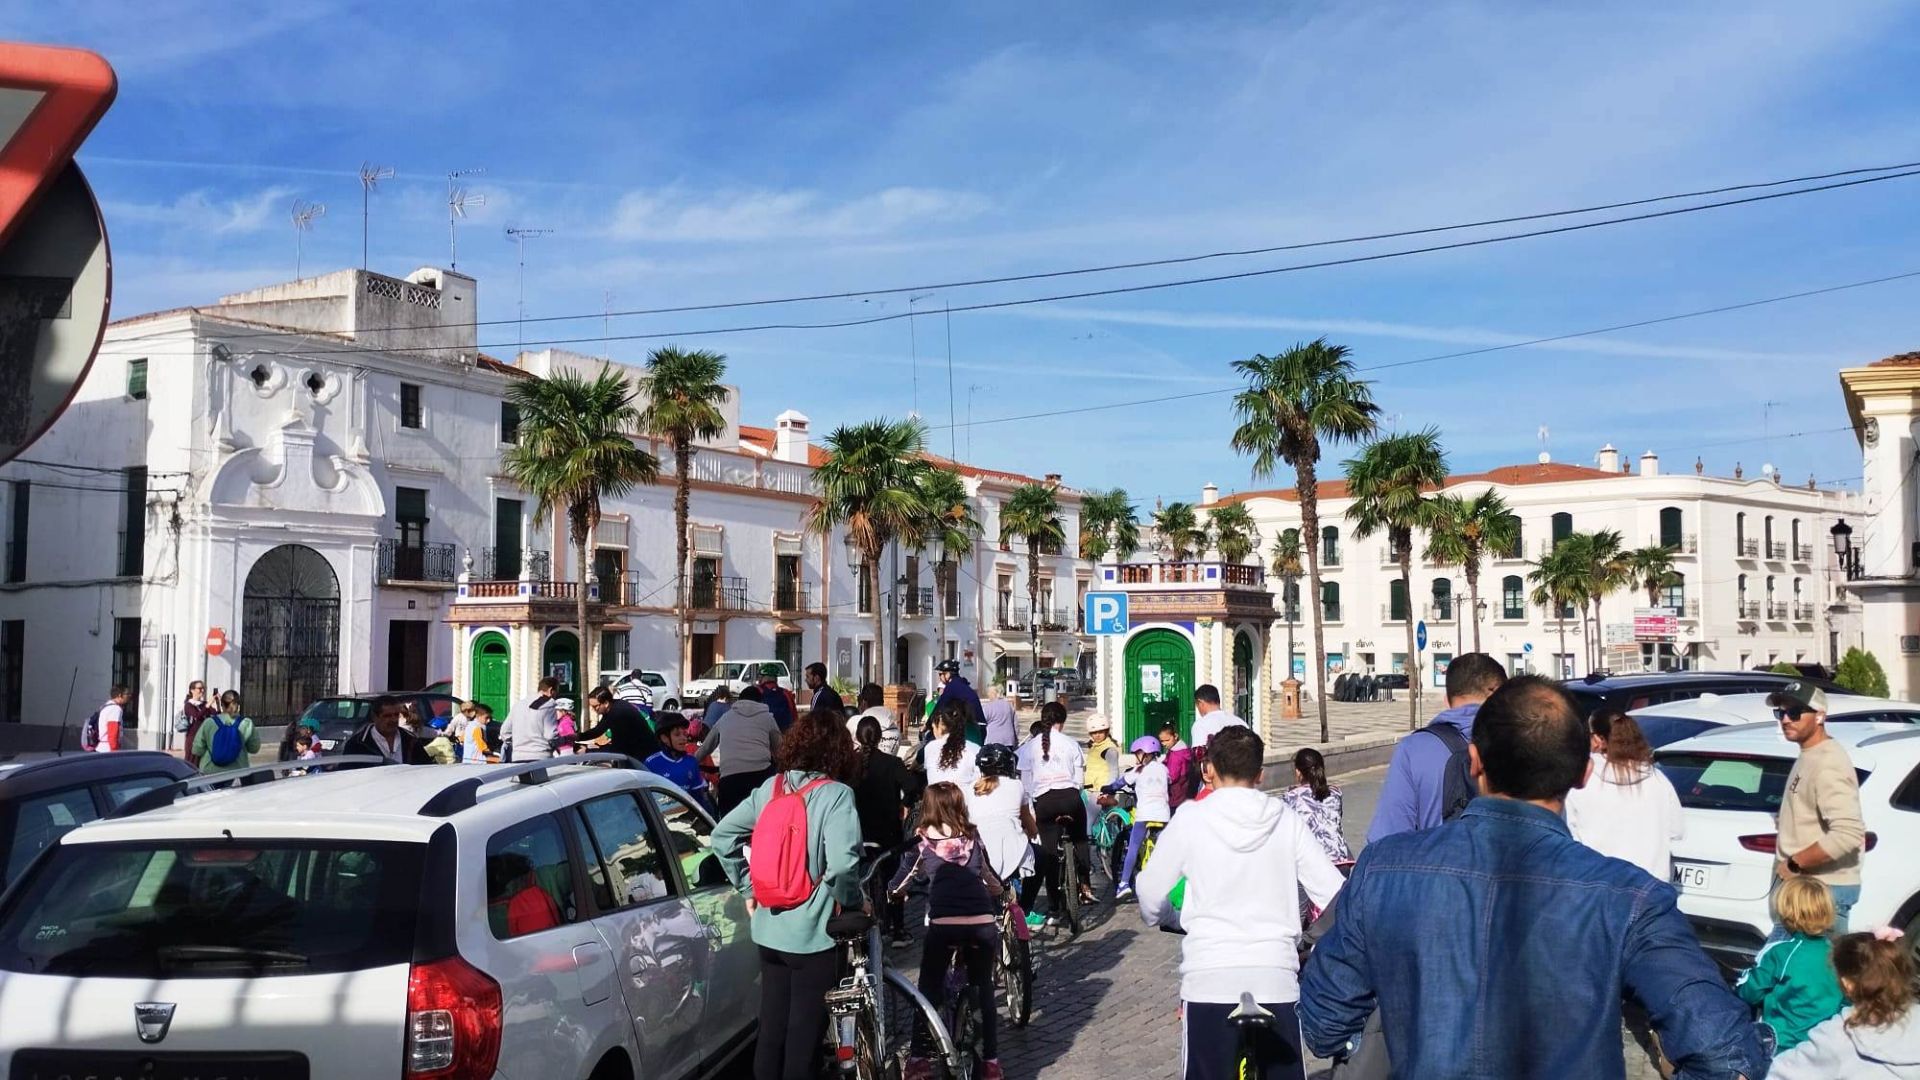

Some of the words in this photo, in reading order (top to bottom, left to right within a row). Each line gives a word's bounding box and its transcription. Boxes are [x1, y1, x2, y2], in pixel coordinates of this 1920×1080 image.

[1093, 597, 1119, 631] P
[1432, 641, 1452, 649] BBVA
[1673, 866, 1705, 886] MFG
